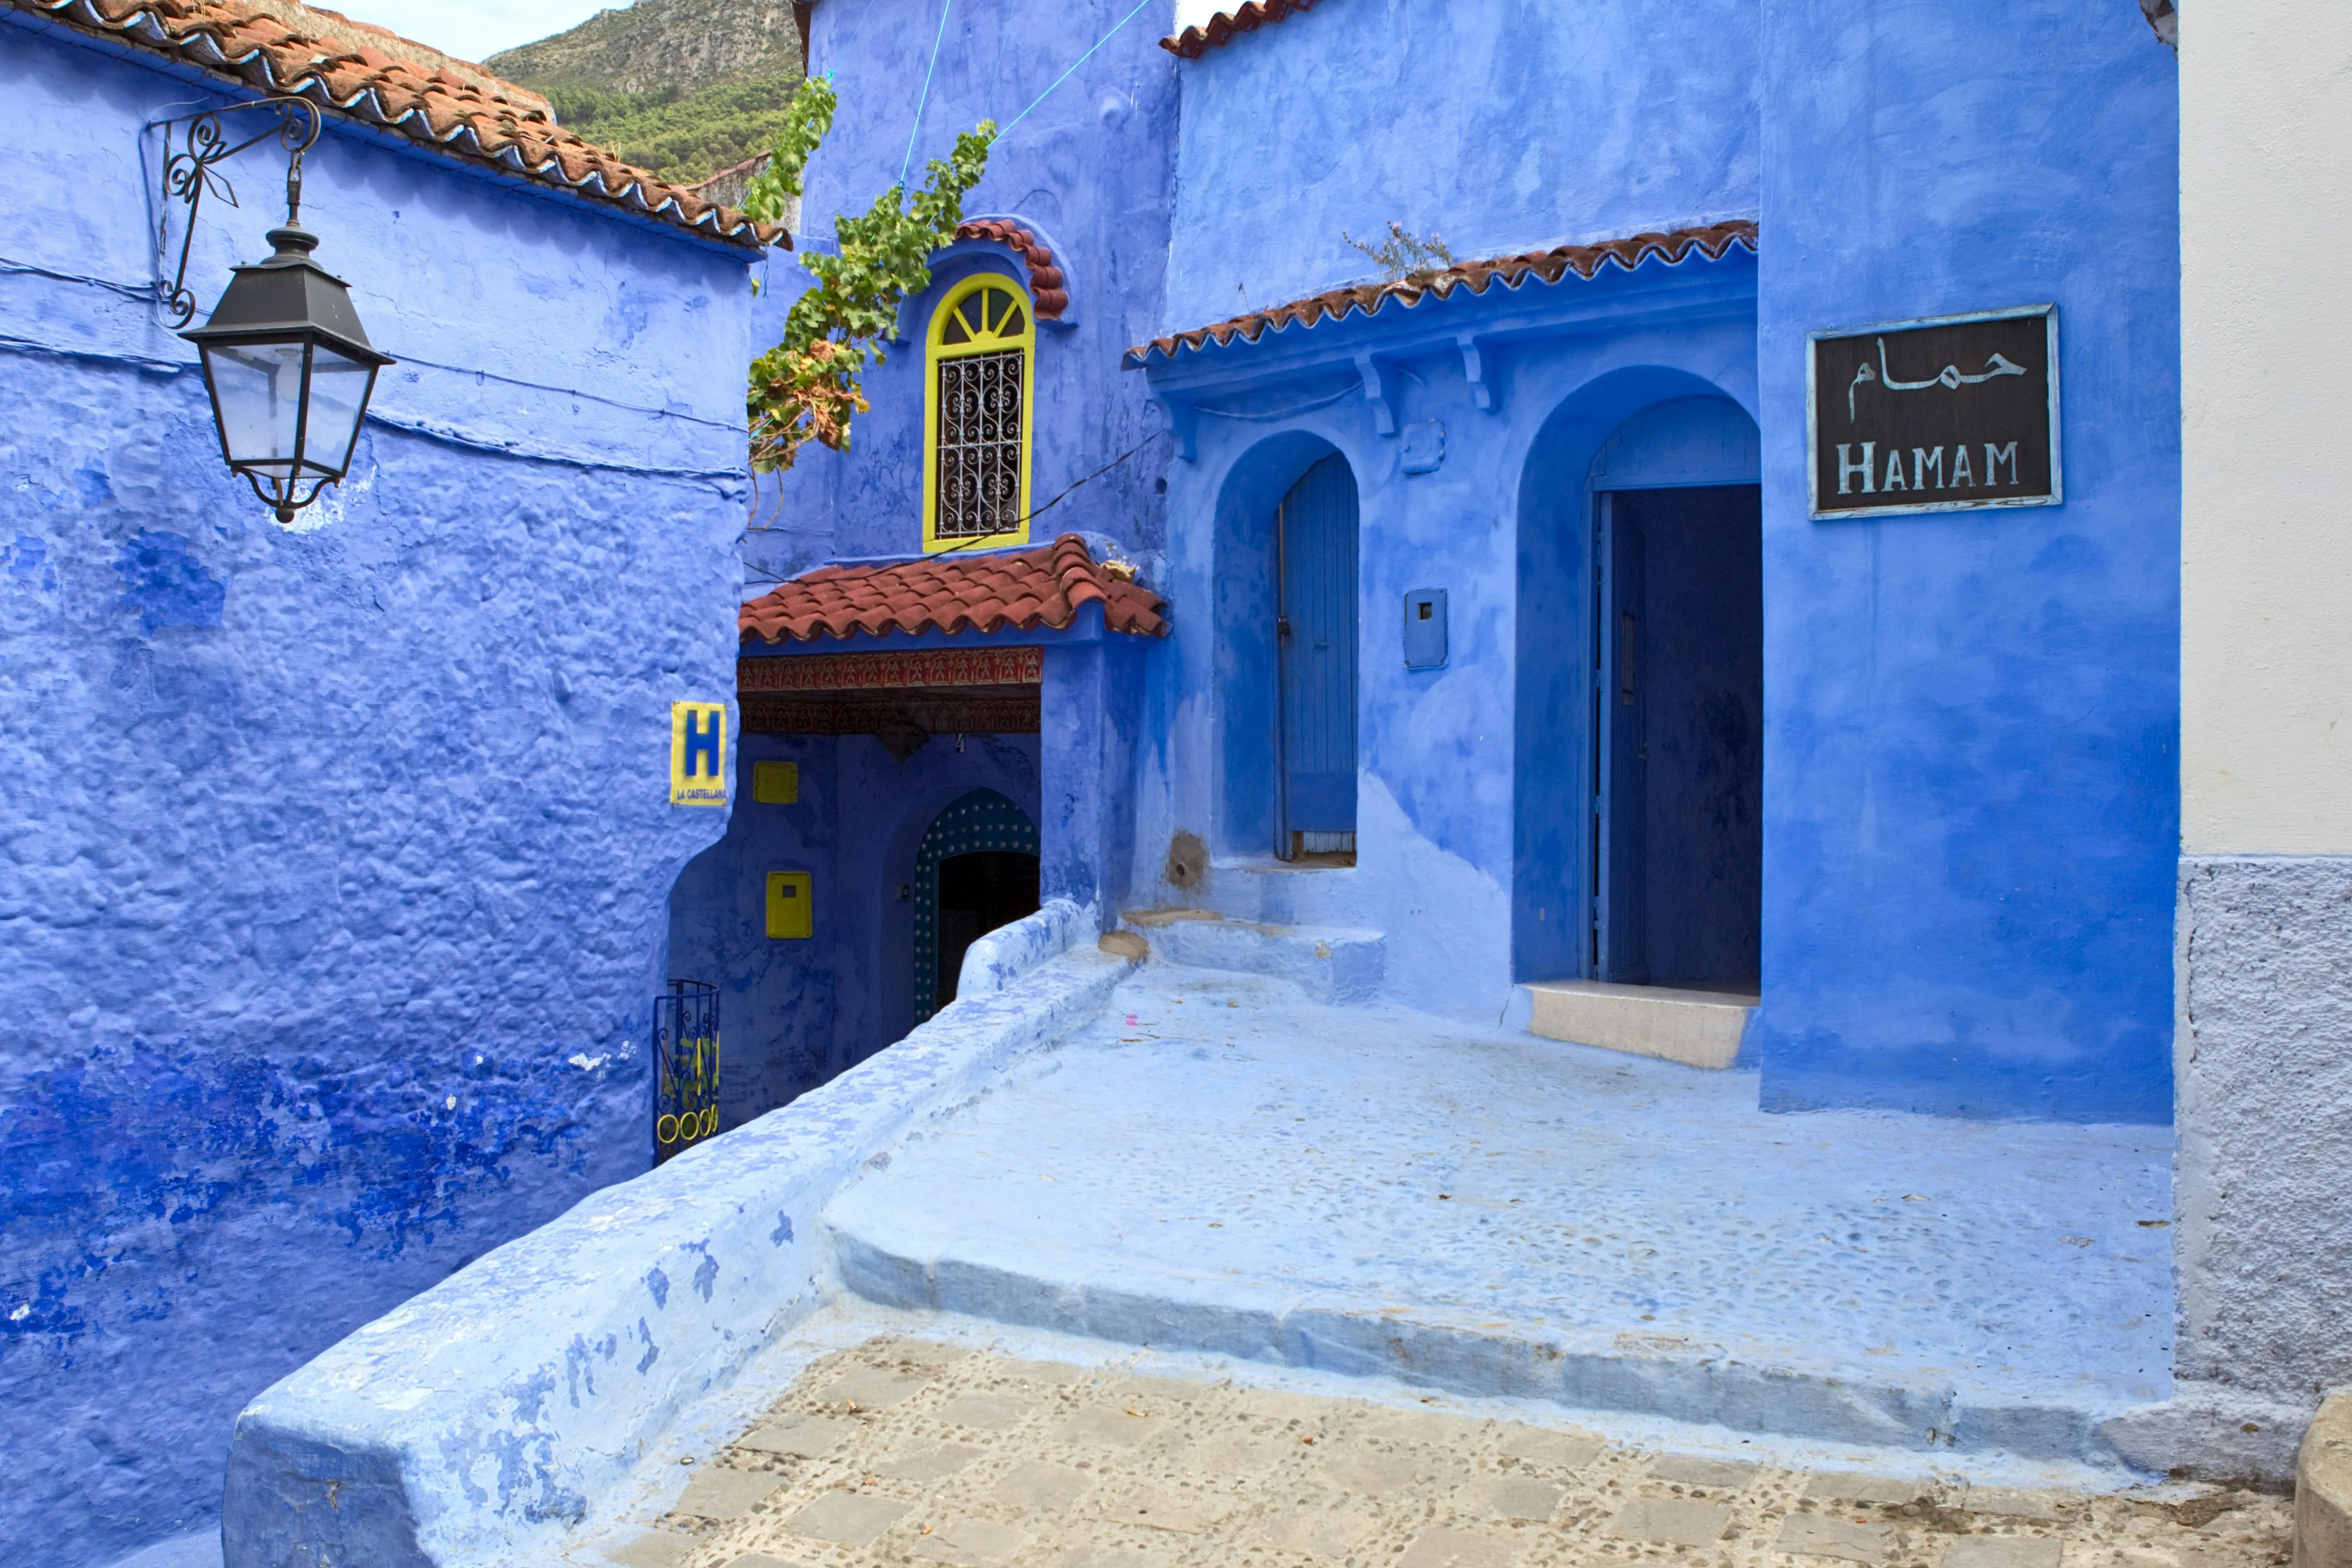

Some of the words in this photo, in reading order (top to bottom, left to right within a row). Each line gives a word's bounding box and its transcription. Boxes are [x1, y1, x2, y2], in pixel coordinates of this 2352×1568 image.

[1849, 337, 2027, 423] حمام
[1836, 441, 2019, 494] HAMAM
[686, 710, 720, 776] H
[956, 733, 965, 753] 4
[677, 789, 685, 799] LA
[687, 789, 726, 799] CASTELLANA
